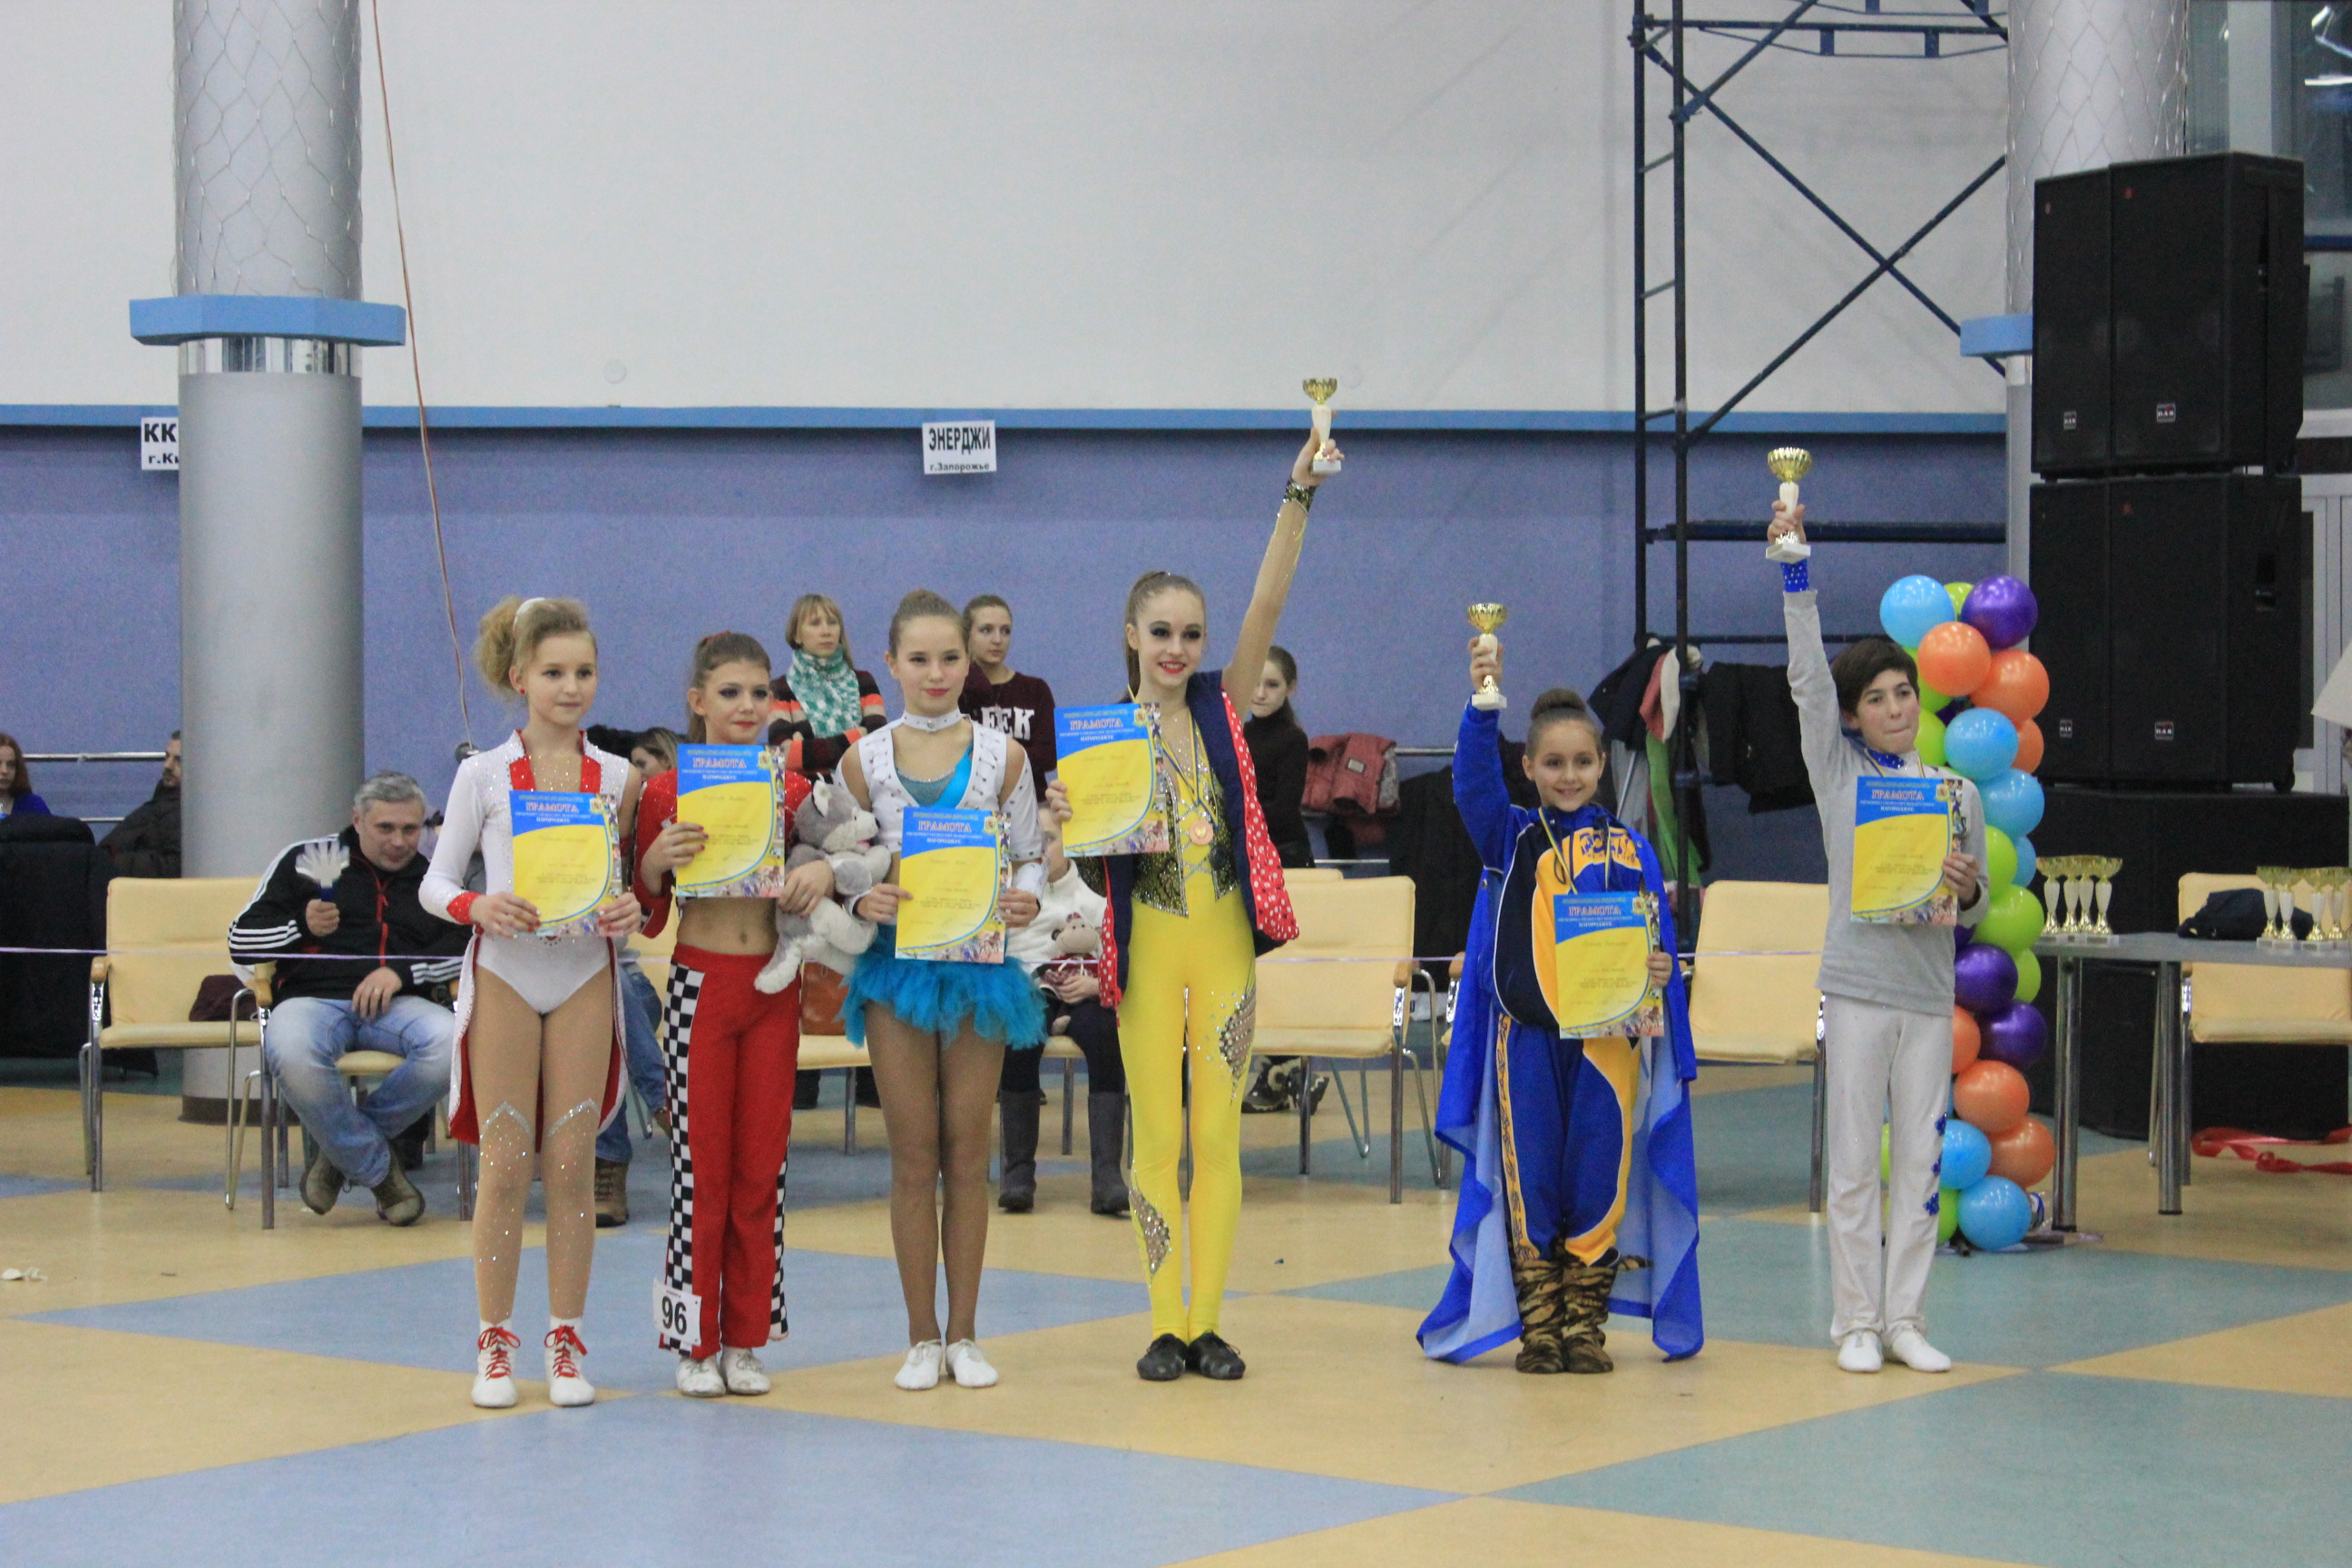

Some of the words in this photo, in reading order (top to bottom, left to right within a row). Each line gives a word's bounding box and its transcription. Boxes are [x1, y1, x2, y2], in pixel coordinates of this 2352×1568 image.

[929, 426, 991, 455] ЭНЕРДЖИ
[930, 462, 990, 474] г.Запорожье
[1069, 718, 1123, 730] ГРАМОТА
[692, 757, 747, 769] ГРАМОТА
[1871, 789, 1925, 800] ГРАМОТА
[525, 801, 580, 813] ГРАМОТА
[917, 819, 972, 833] ГРАМОТА
[1568, 905, 1622, 916] ГРАМОТА
[662, 1295, 688, 1336] 96
